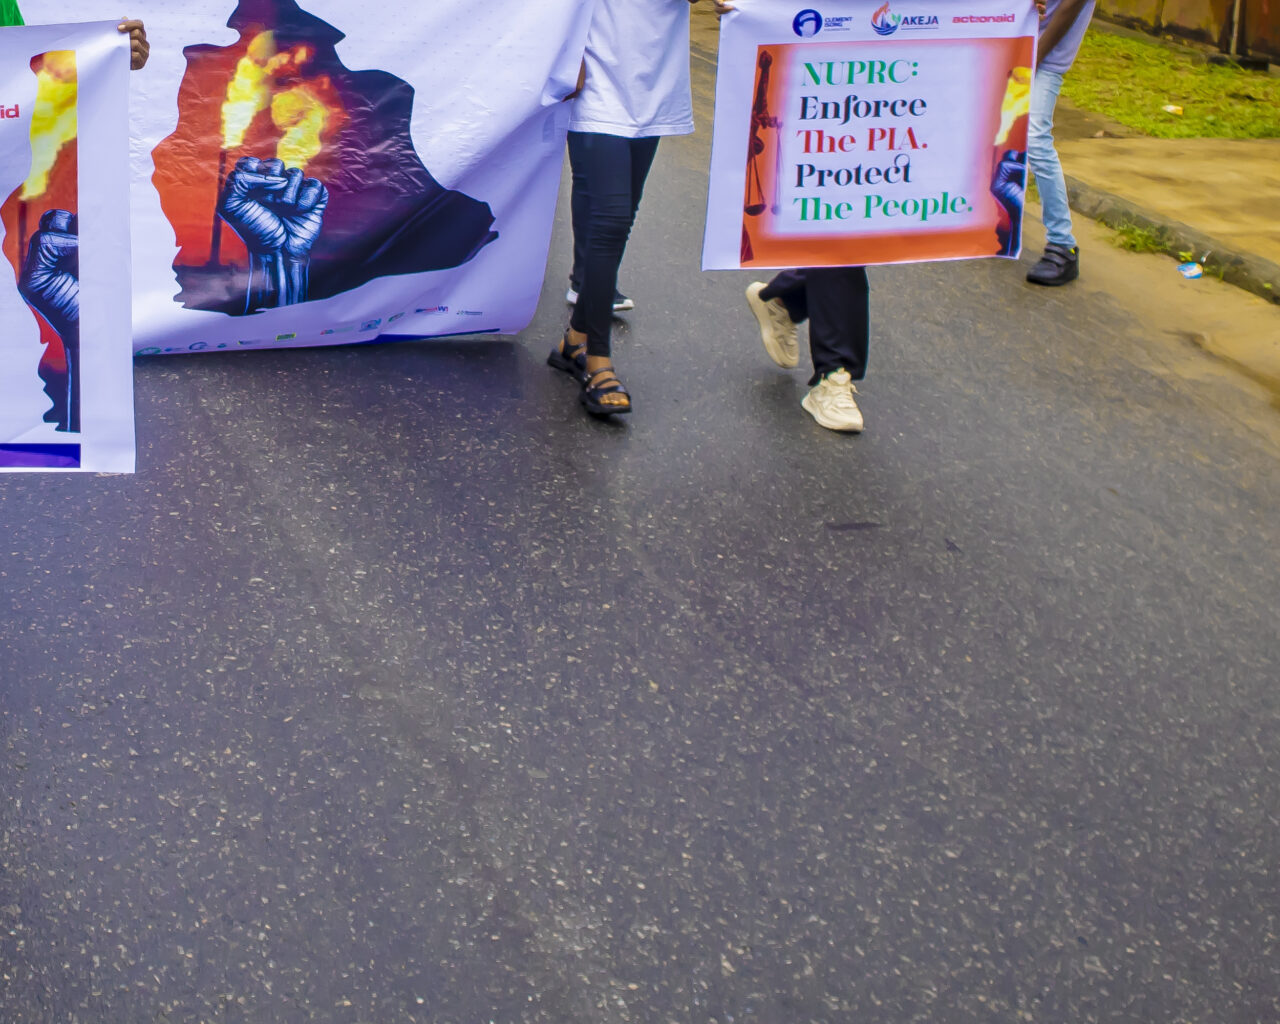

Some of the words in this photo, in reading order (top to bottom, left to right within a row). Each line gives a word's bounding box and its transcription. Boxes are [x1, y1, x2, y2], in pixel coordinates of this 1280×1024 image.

[901, 15, 939, 26] AKEJA
[801, 59, 919, 86] NUPRC:
[798, 94, 927, 126] Enforce
[796, 129, 857, 153] The
[867, 126, 928, 152] PIA.
[794, 153, 912, 188] Protect
[792, 196, 853, 221] The
[863, 191, 973, 221] People.
